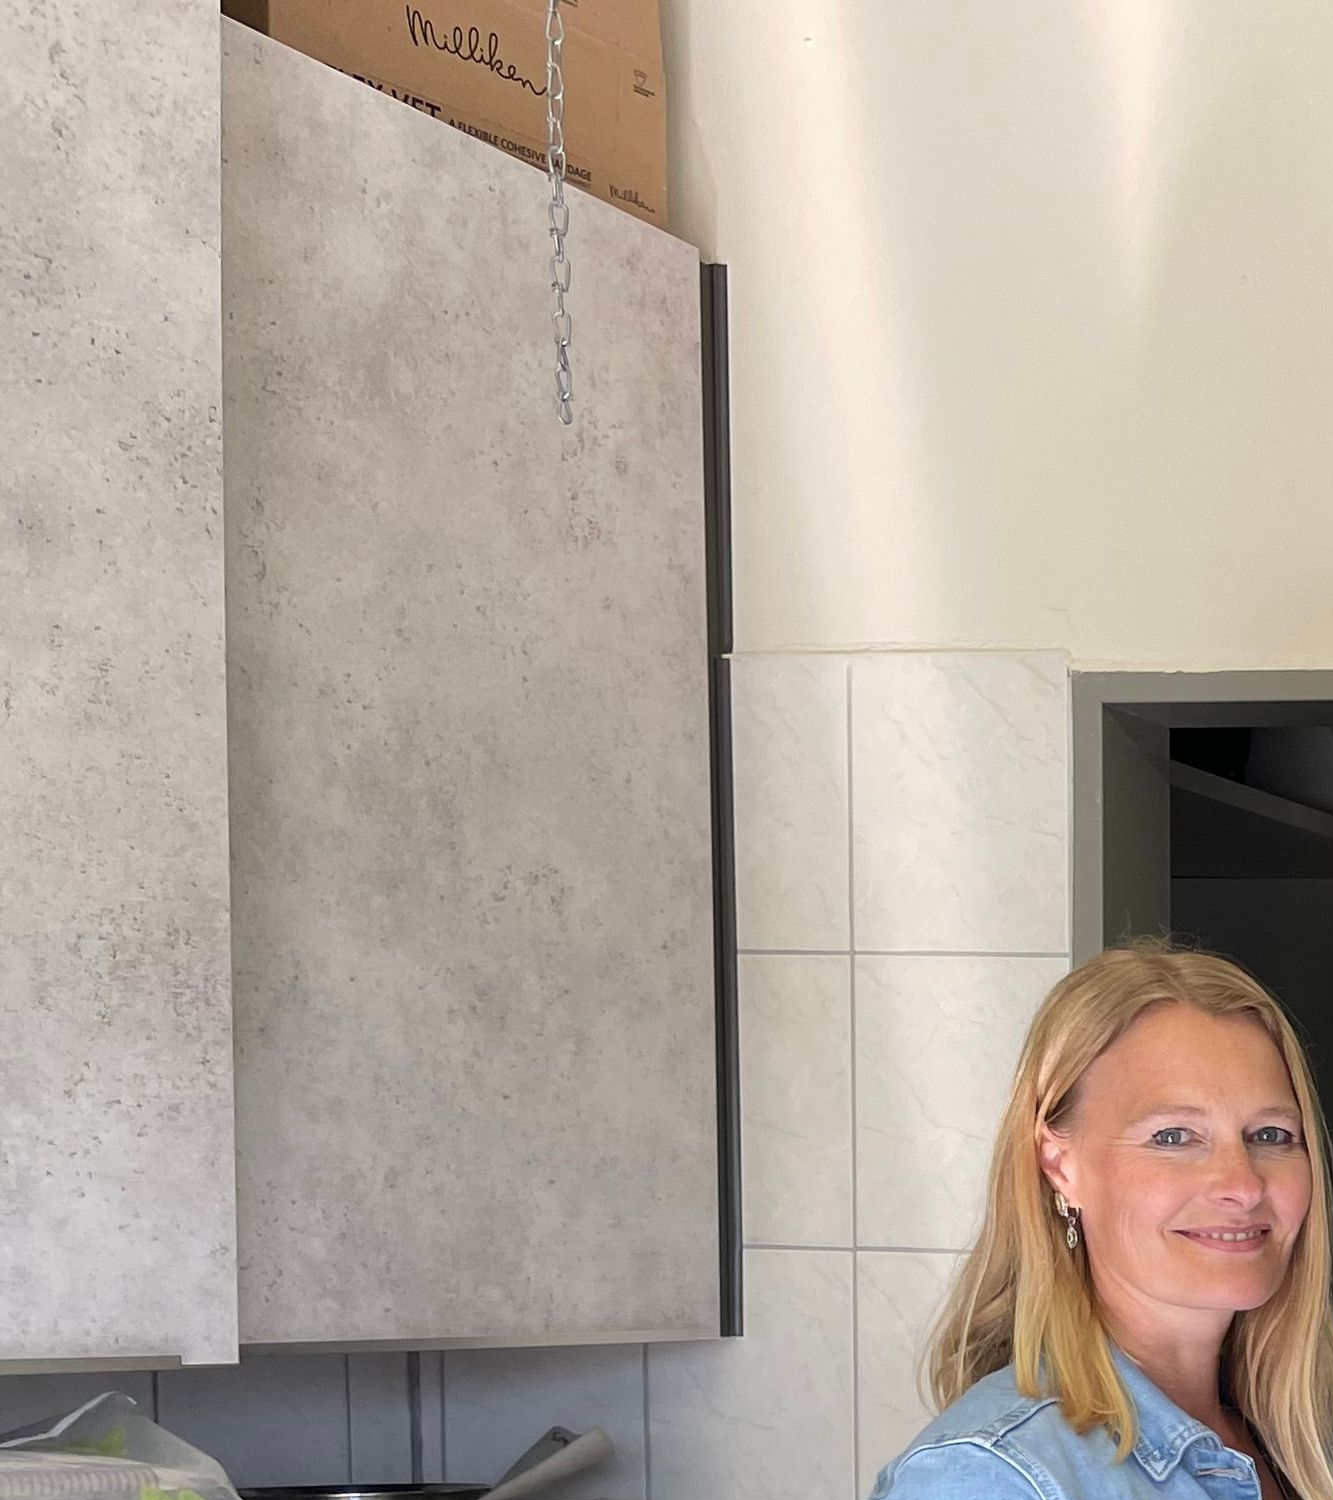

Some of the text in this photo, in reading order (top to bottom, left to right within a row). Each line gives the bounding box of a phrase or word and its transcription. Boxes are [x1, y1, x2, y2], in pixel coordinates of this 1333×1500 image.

[405, 4, 548, 97] Milliken
[500, 138, 547, 164] COHESIVE
[548, 155, 592, 182] ADAGE
